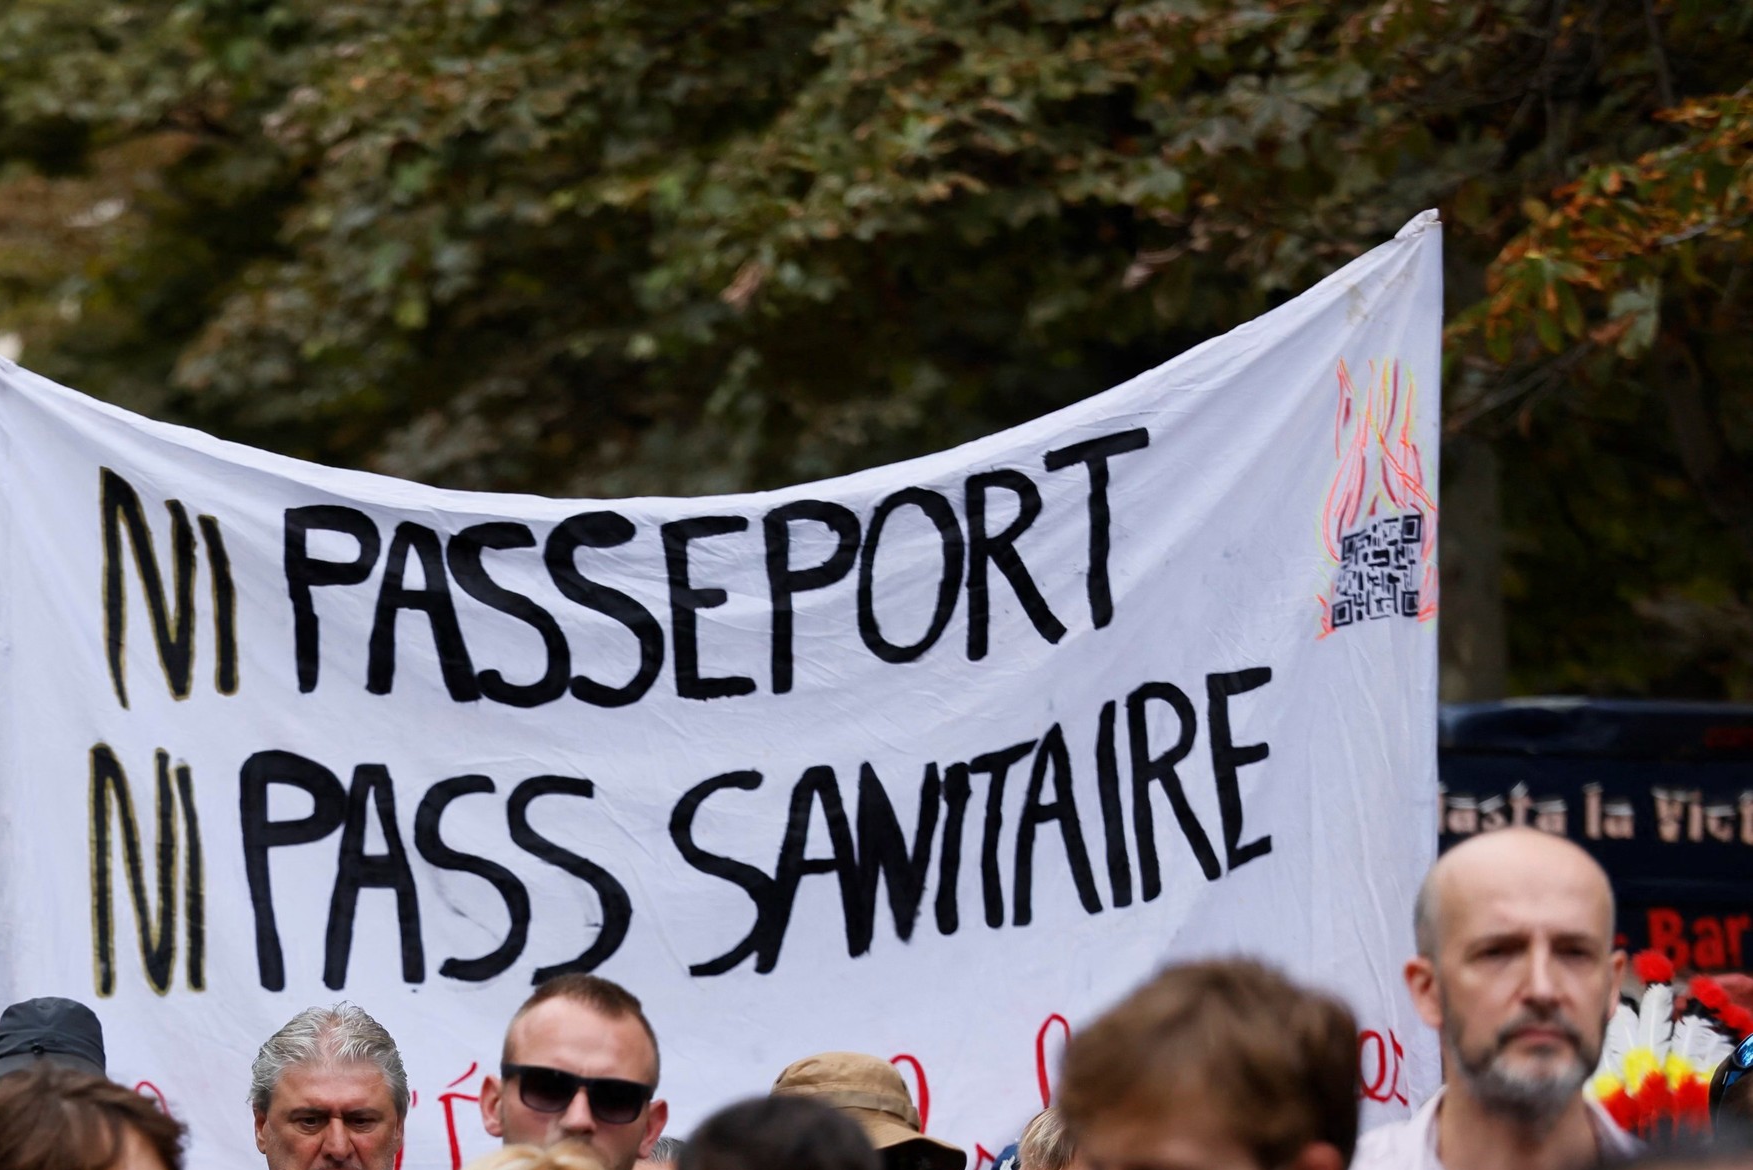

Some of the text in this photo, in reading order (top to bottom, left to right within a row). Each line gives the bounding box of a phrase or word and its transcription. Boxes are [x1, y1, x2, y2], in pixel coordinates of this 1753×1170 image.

[98, 426, 1151, 709] NI PASSEPORT
[89, 665, 1273, 997] NI PASS SANITAIRE
[1439, 780, 1568, 838] asta
